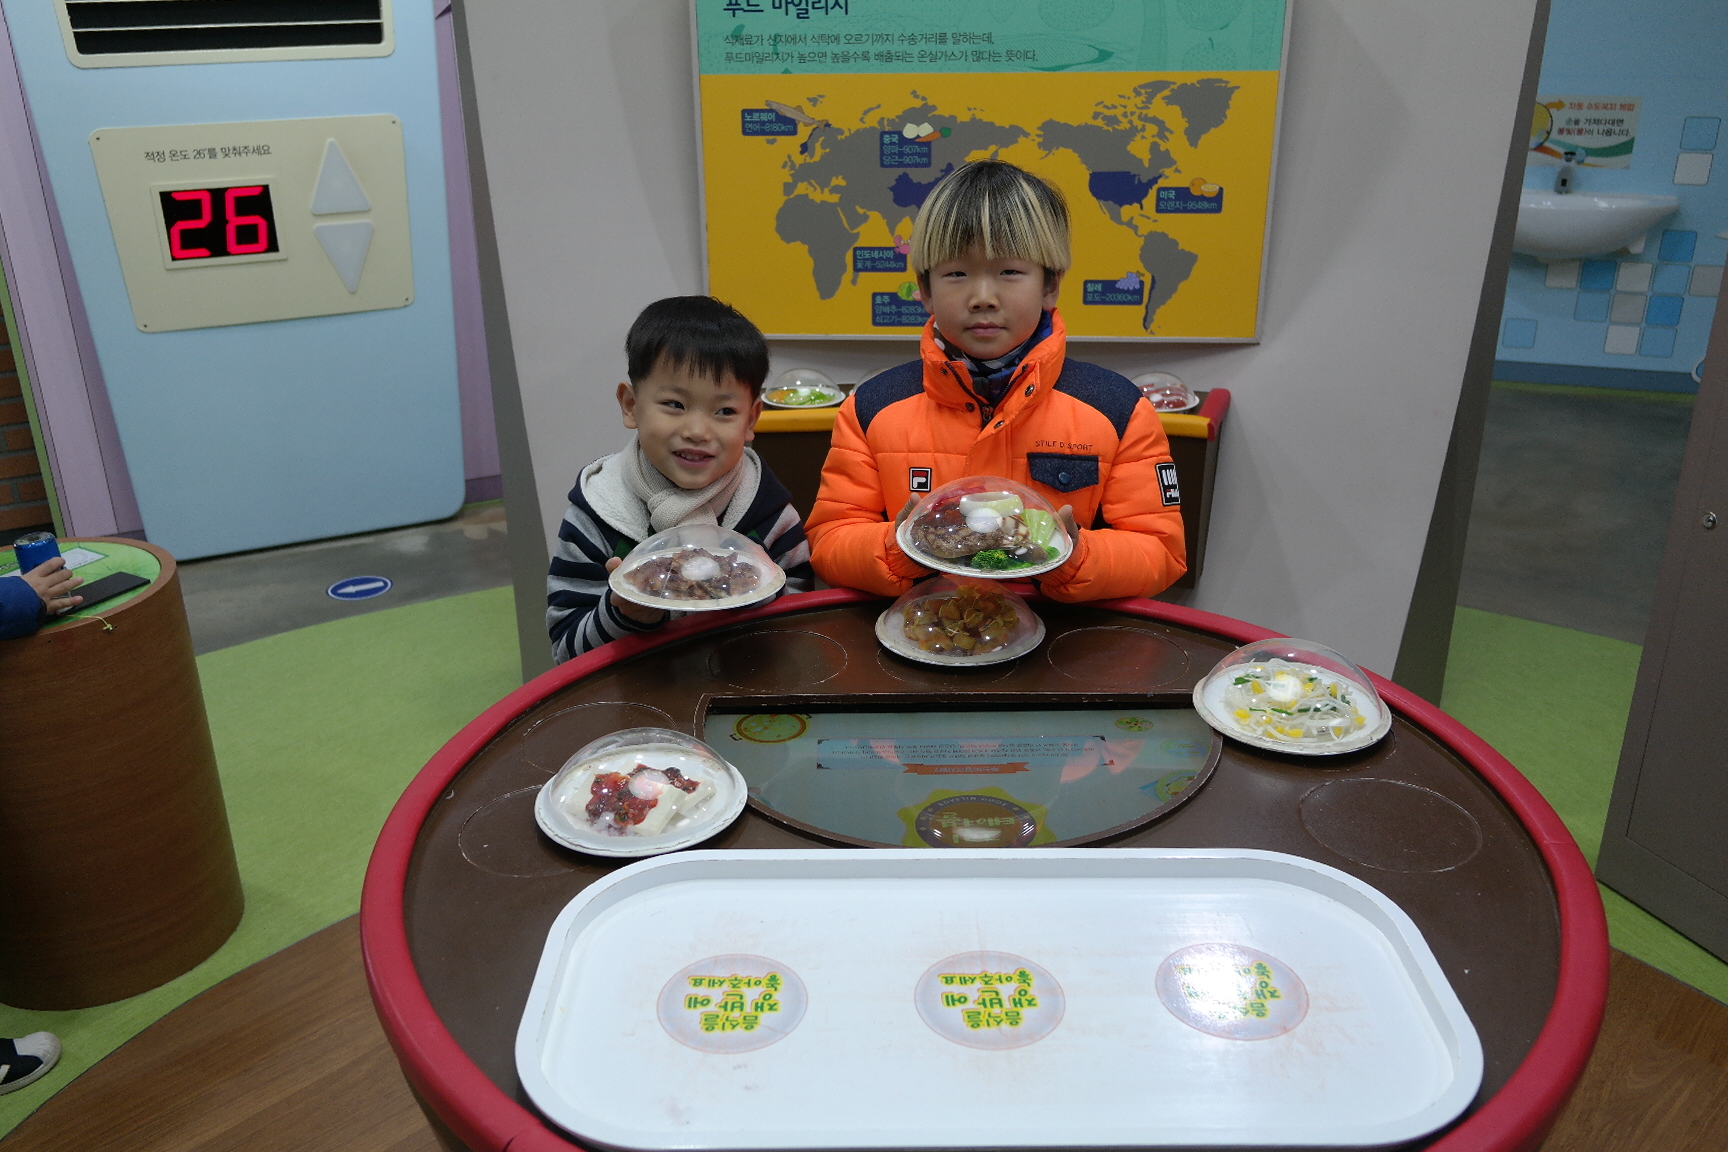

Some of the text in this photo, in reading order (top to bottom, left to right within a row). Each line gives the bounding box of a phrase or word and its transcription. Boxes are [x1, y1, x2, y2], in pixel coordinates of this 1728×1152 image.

[724, 32, 994, 46] 식재료가 산지에서 식탁에 오르기까지 수송거리를 말하는데,
[724, 49, 1038, 64] 푸드마일리지가 높으면 높을수록 배출되는 온실가스가 많다는 뜻이다.
[744, 112, 775, 122] 노르웨이
[883, 134, 899, 144] 중국
[144, 150, 166, 163] 적정
[169, 149, 191, 162] 온도
[220, 144, 272, 159] 맞춰주세요
[1159, 190, 1176, 200] 미국
[169, 186, 269, 260] 26
[856, 250, 894, 259] 인도네시아
[1086, 283, 1102, 292] 칠레
[875, 295, 890, 304] 호주
[1067, 443, 1093, 451] SPORT
[690, 974, 781, 991] 놓아주세요
[940, 970, 1032, 987] 놓아주세요
[686, 992, 780, 1013] 쟁반에
[944, 988, 1038, 1009] 쟁반에
[702, 1013, 759, 1033] 음식을
[964, 1010, 1023, 1030] 음식을
